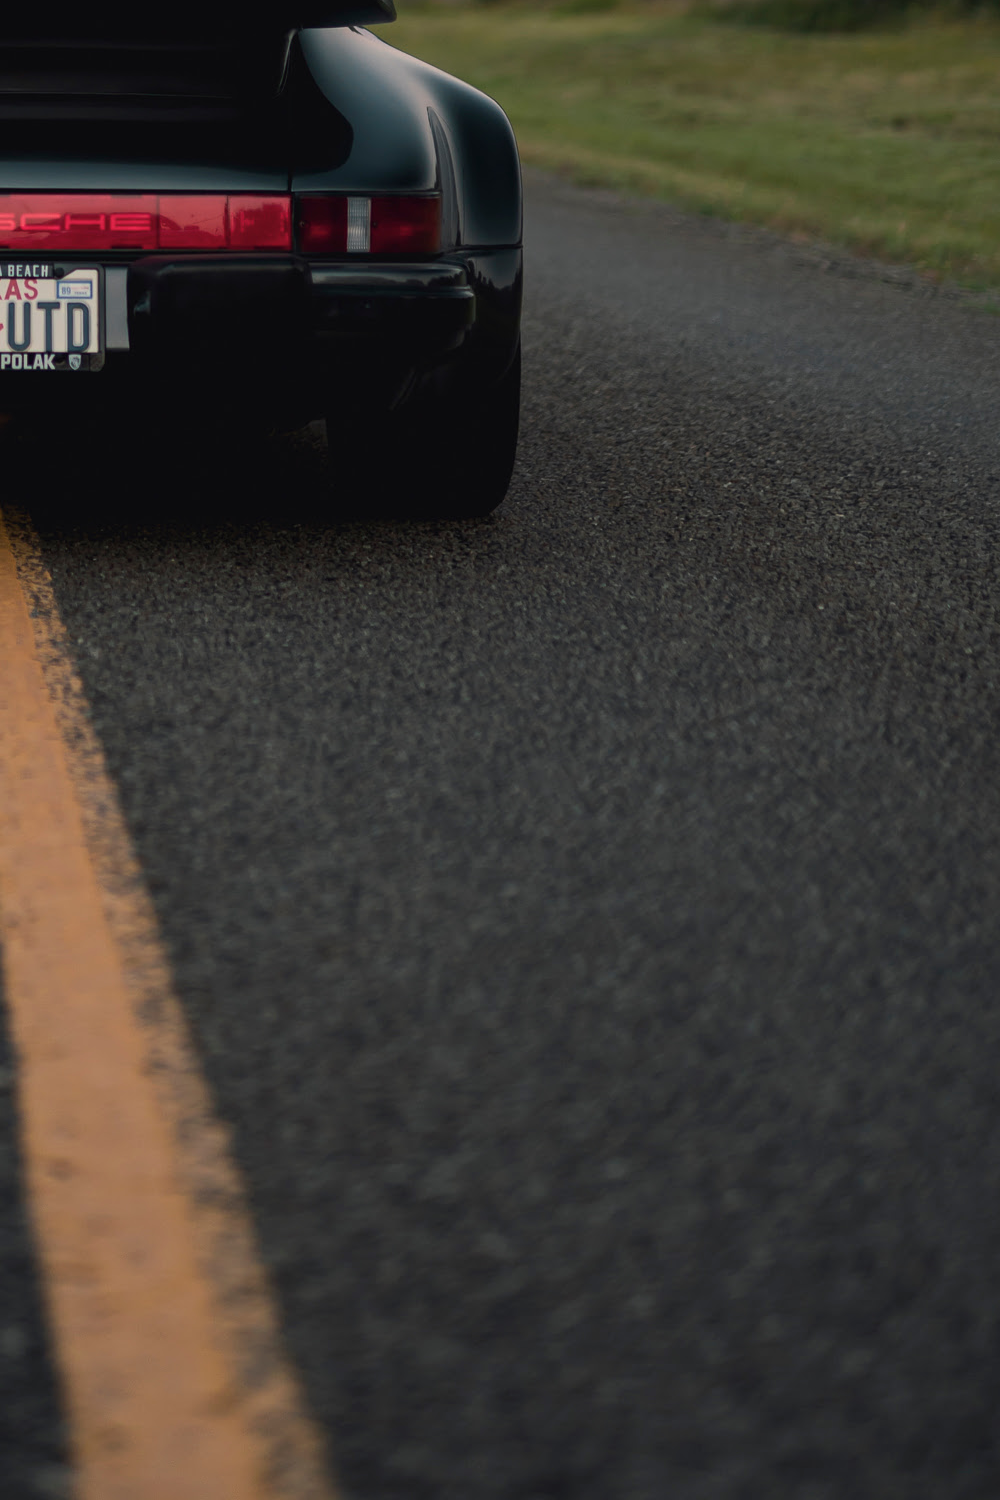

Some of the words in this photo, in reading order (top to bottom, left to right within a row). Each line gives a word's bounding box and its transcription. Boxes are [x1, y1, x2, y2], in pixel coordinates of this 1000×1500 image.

[8, 264, 49, 277] BEACH
[7, 301, 90, 352] UTD
[0, 353, 55, 370] POLAK
